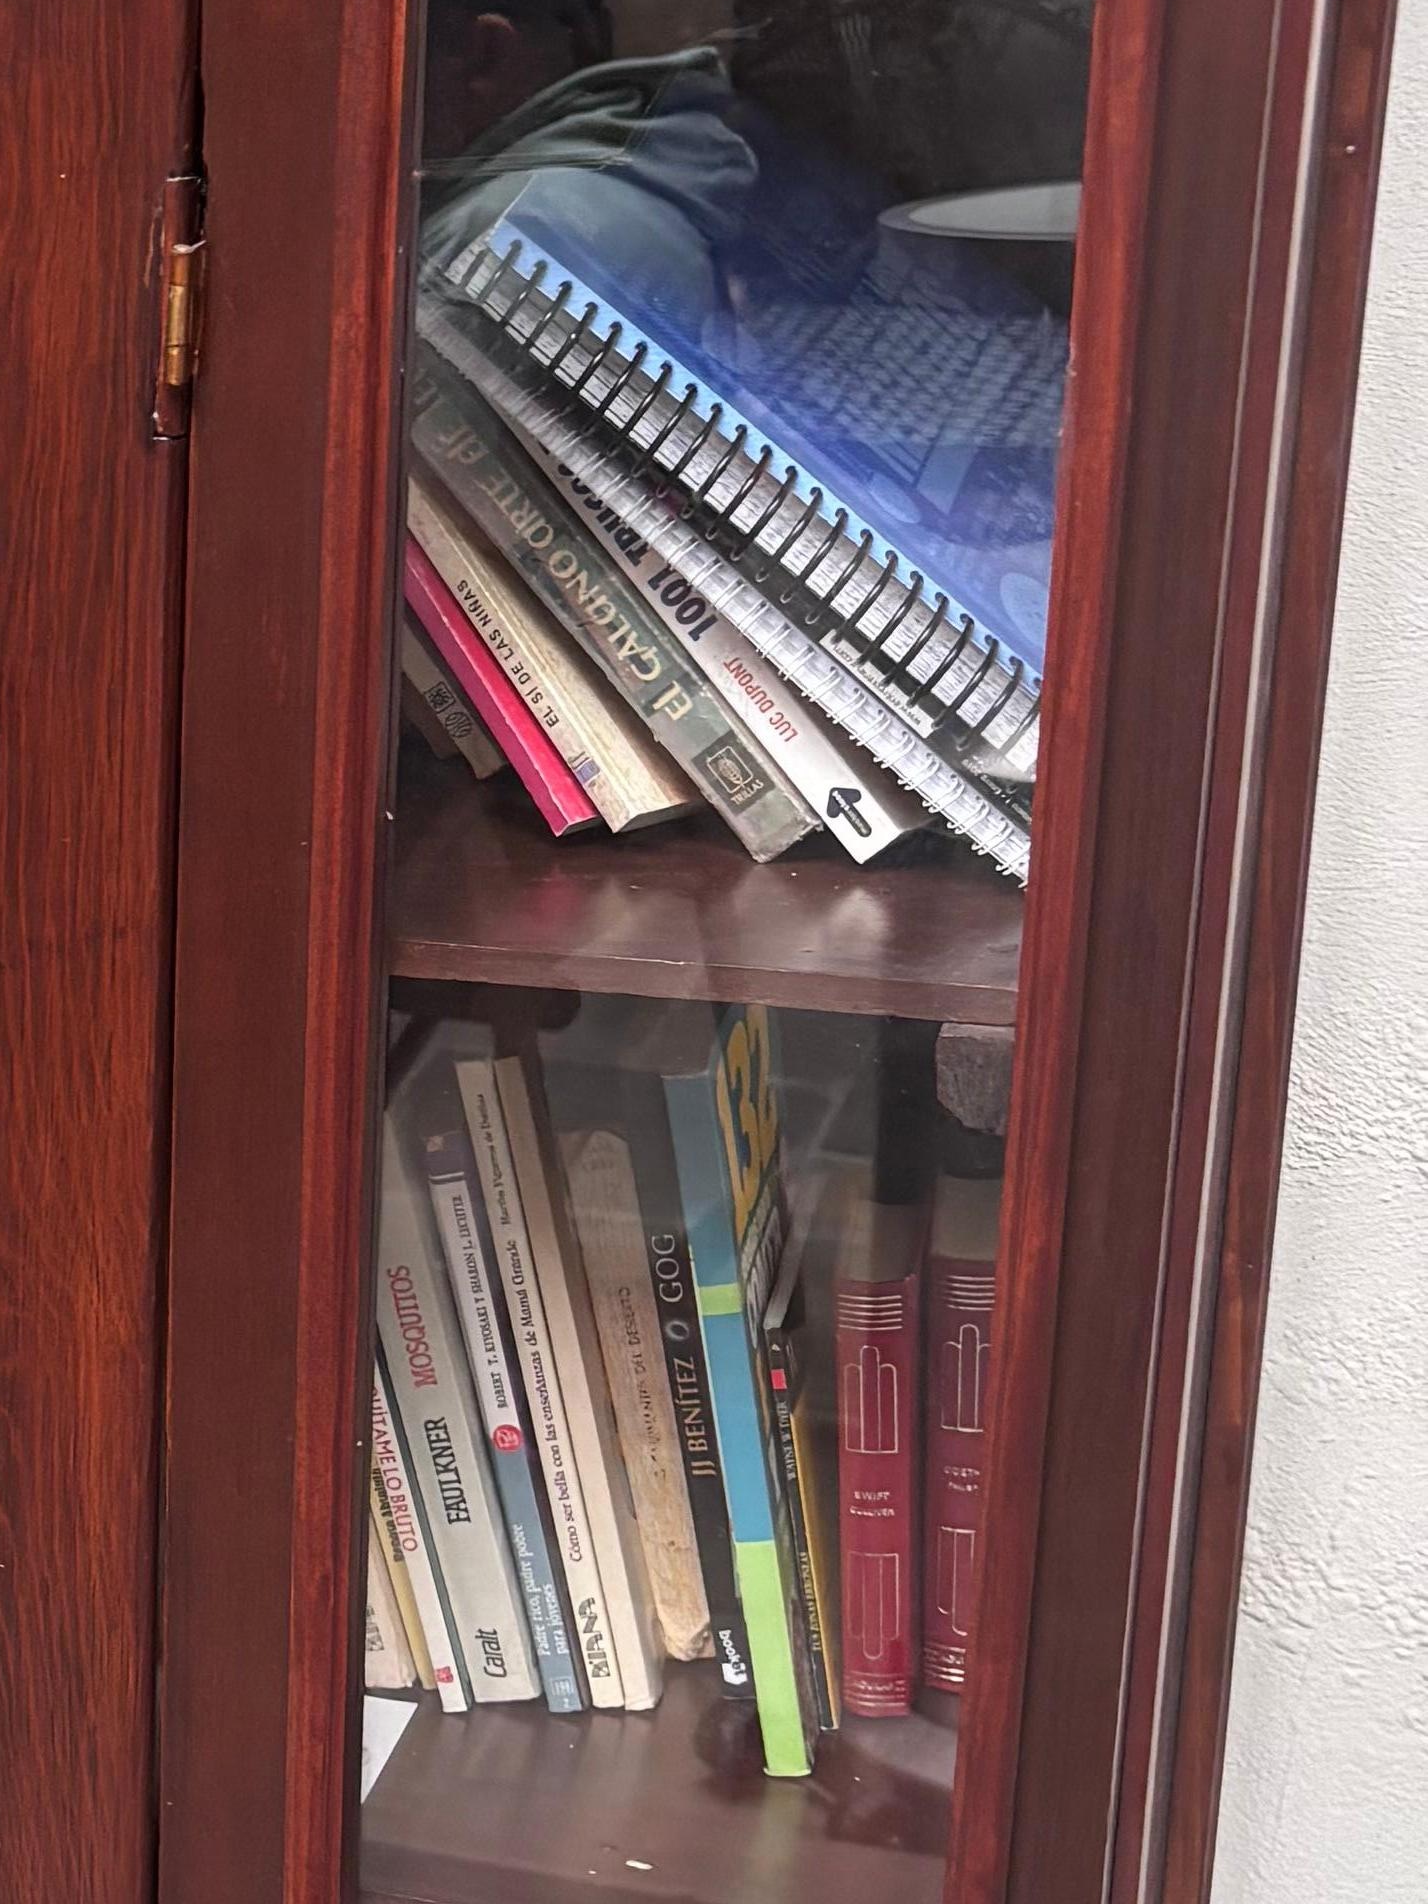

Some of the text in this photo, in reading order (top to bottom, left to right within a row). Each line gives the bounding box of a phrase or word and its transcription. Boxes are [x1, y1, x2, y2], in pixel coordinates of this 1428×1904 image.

[645, 559, 721, 645] 1001
[452, 575, 562, 730] EL SÍ DE LAS NIÑAS
[721, 651, 800, 745] LUC DUPONT
[384, 1262, 440, 1391] MOSQUITOS
[649, 1230, 716, 1481] JJ BENÍTEZ GOG
[489, 1370, 508, 1409] ROBERT
[502, 1237, 584, 1563] Cómo ser bella con las enseñanzas de Mamá Grande
[382, 1465, 403, 1492] LO
[422, 1413, 472, 1528] FAULKNER
[852, 1488, 890, 1502] SWIFT
[388, 1492, 419, 1554] BRUTO
[510, 1520, 552, 1658] Padre rico, padre pobre
[539, 1581, 569, 1656] para jóvenes
[473, 1625, 507, 1679] Caralt
